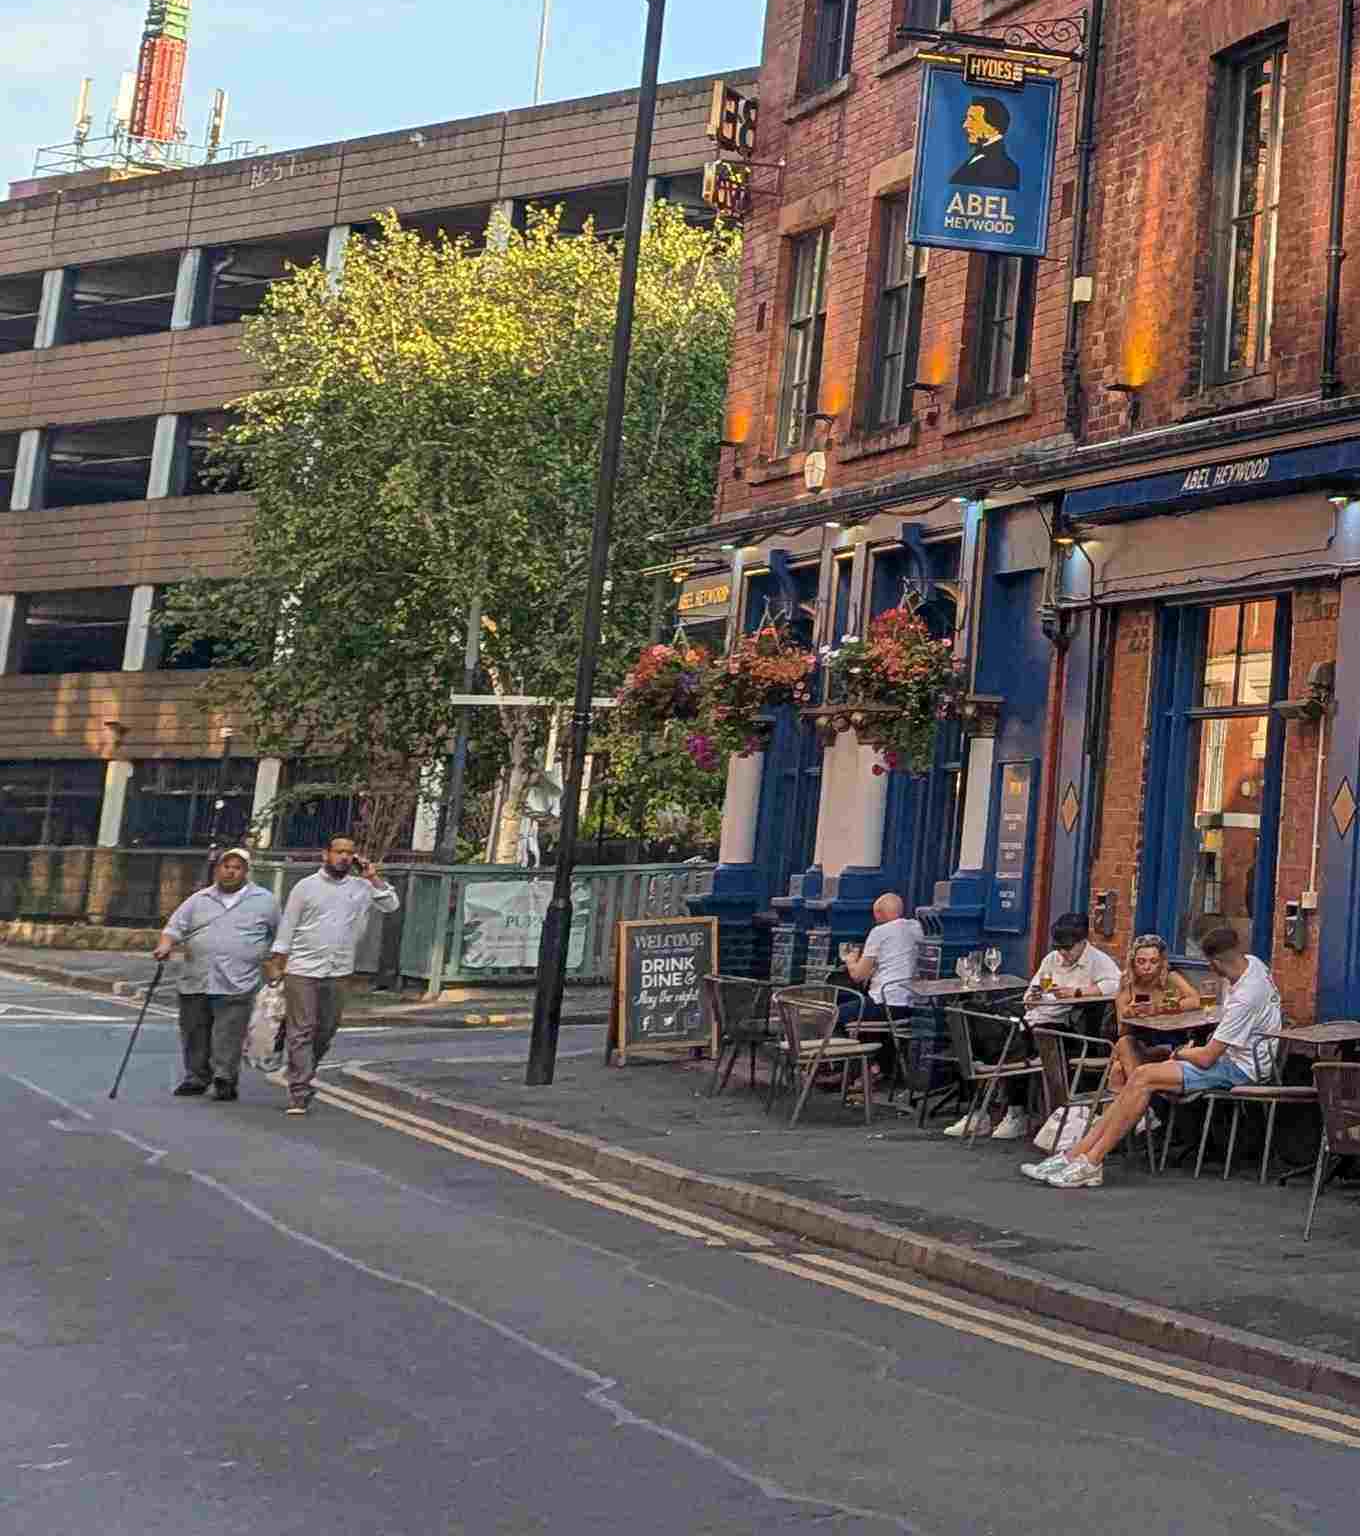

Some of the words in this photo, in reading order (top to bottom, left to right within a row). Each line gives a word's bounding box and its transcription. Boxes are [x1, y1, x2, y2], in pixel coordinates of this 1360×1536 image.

[970, 57, 1012, 80] HYDES
[946, 191, 1015, 220] ABEL
[944, 215, 1015, 235] HEYWOOD
[1180, 467, 1210, 491] ABEL
[1213, 457, 1269, 486] HEYWOOD
[633, 931, 704, 951] WELCOME
[641, 955, 696, 974] DRINK
[641, 972, 683, 989] DINE
[684, 971, 697, 985] &
